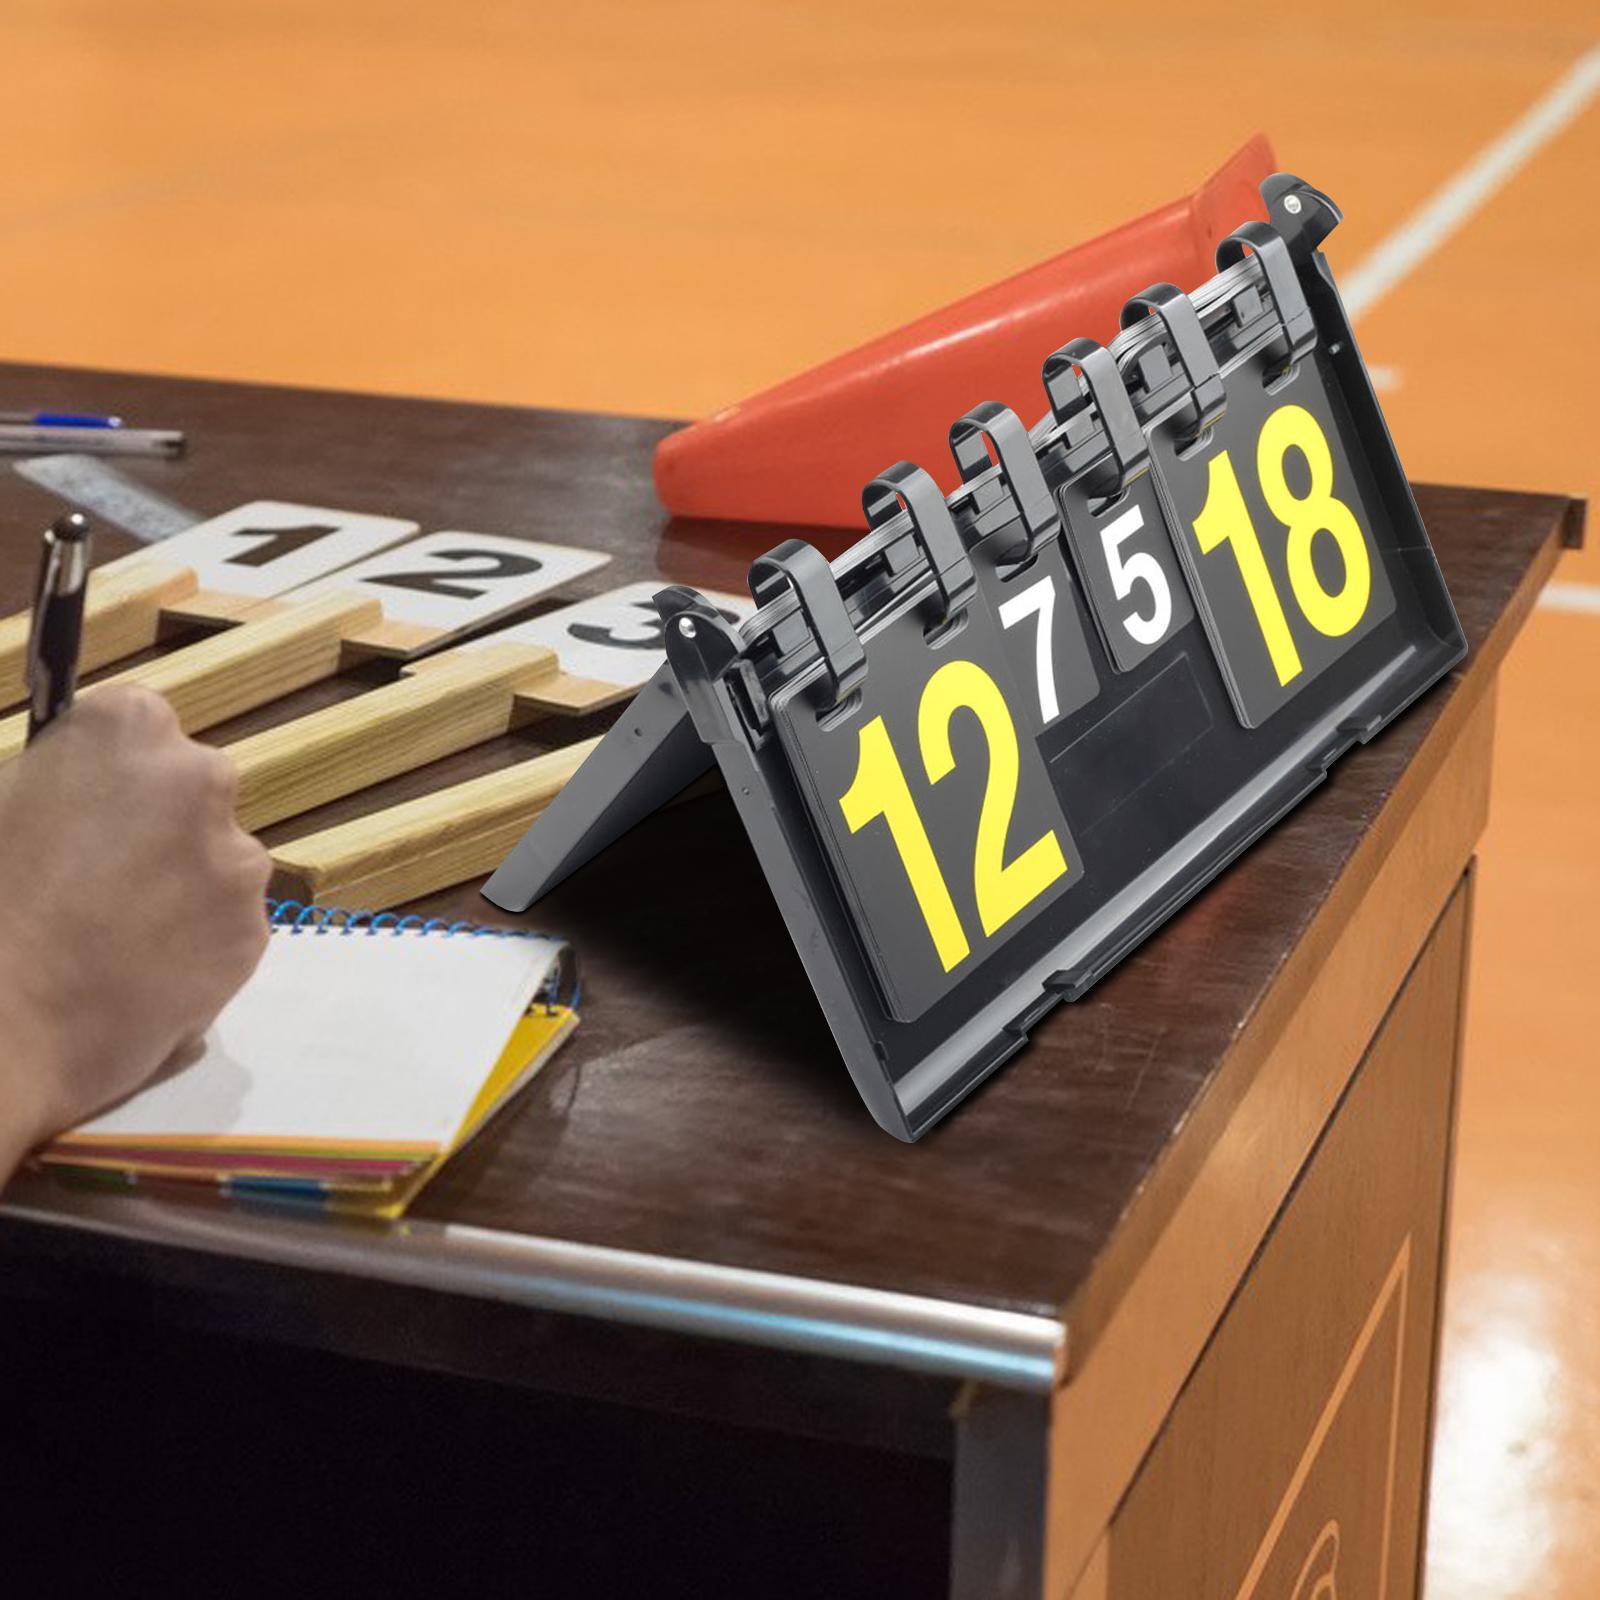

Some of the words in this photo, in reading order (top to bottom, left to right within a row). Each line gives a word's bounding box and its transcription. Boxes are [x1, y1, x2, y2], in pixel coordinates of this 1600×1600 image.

[225, 524, 342, 567] 1
[358, 549, 544, 600] 2
[838, 660, 1068, 973] 12
[998, 575, 1060, 724] 7
[1100, 504, 1172, 645] 5
[1192, 405, 1370, 686] 18
